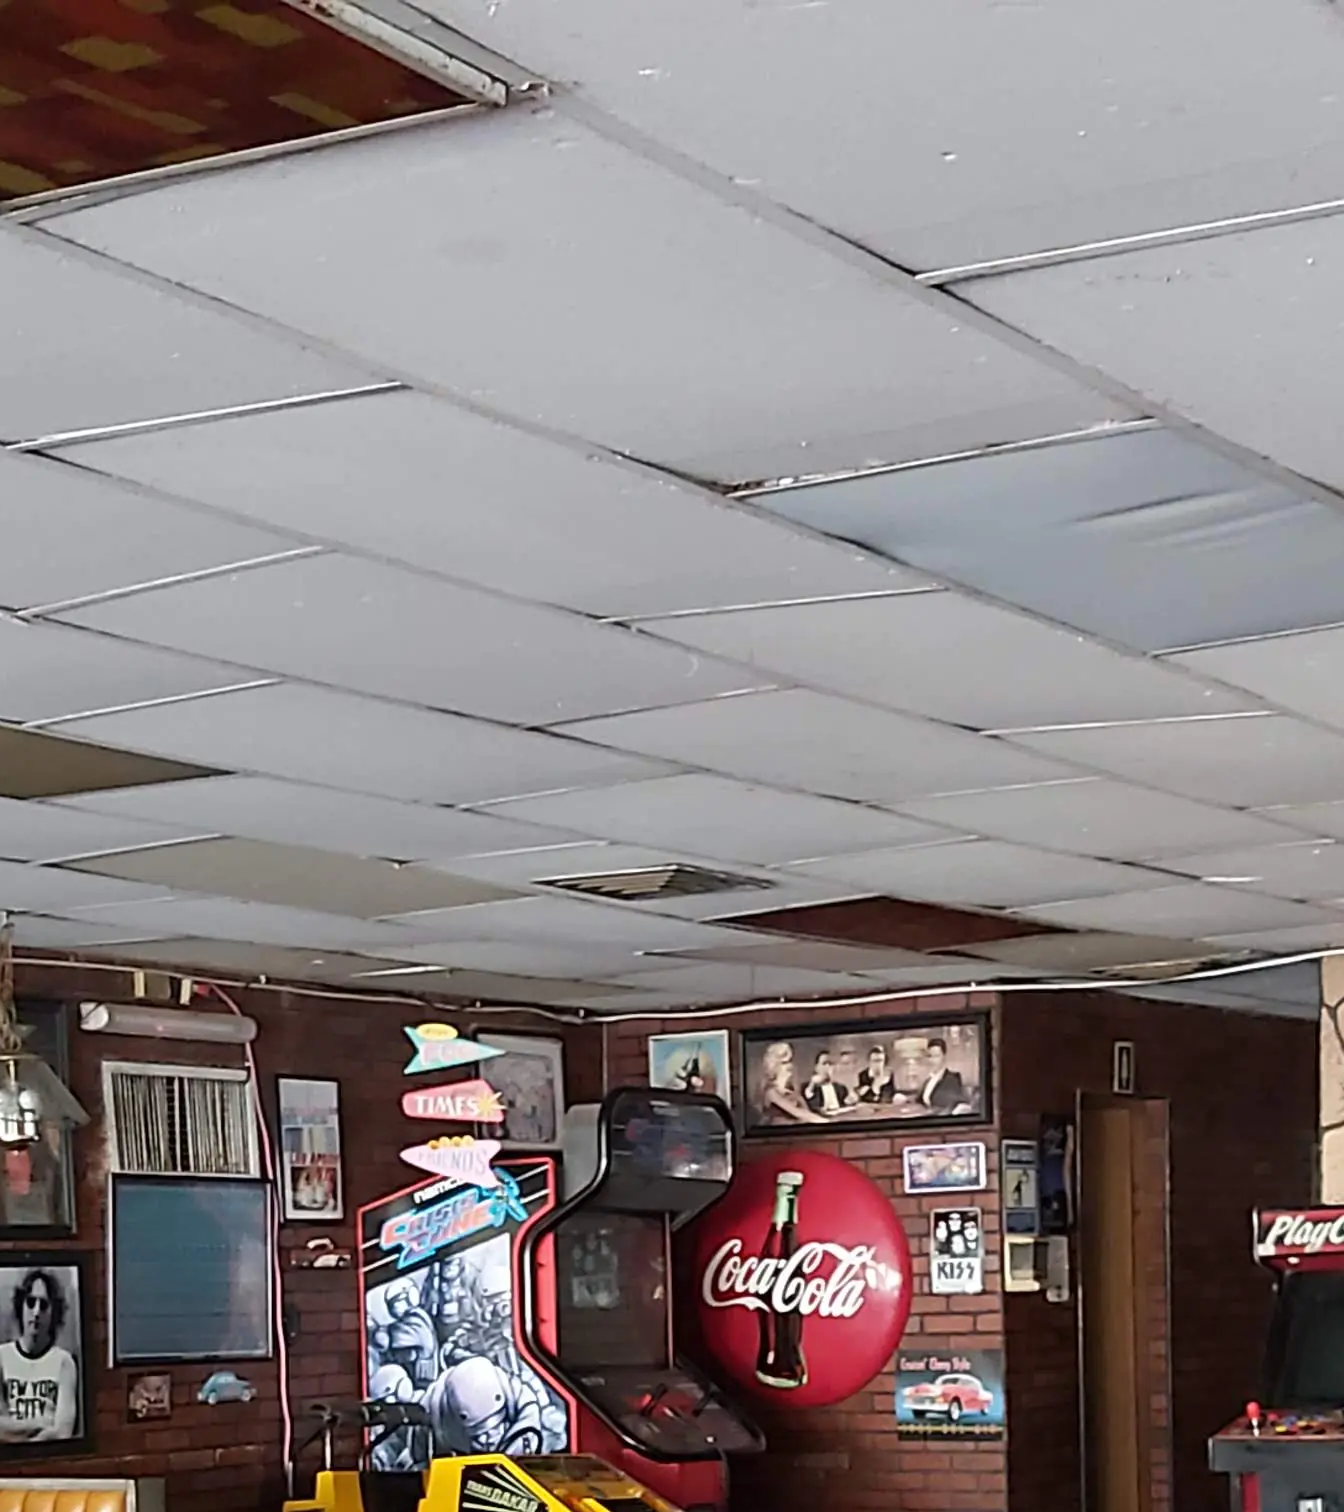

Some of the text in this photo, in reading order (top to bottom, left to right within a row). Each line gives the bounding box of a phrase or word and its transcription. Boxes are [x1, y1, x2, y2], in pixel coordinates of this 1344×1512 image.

[414, 1095, 479, 1117] TIMES
[417, 1149, 487, 1176] FRIENDS
[937, 1262, 975, 1280] KISS
